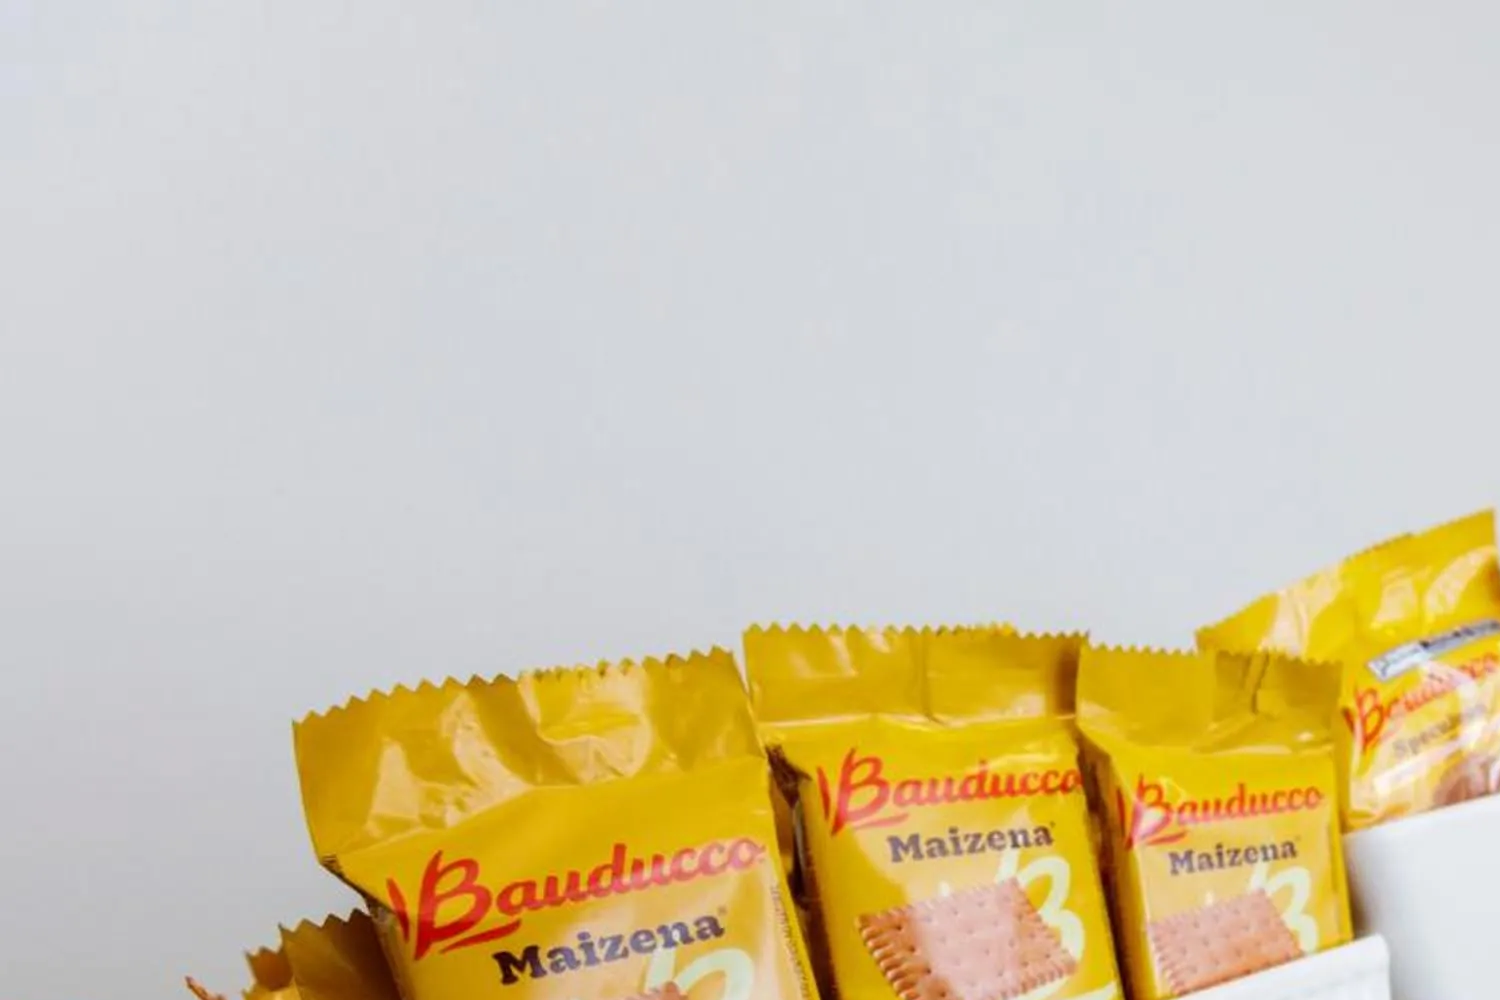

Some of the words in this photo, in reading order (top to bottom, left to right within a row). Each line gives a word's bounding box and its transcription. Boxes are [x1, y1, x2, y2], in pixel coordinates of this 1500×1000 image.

[816, 748, 1084, 838] Bauducco
[1116, 773, 1324, 851] Bauducco
[886, 824, 1054, 863] Maizena
[1168, 840, 1298, 877] Maizena
[386, 836, 766, 960] Bauducco
[492, 912, 727, 985] Maizena
